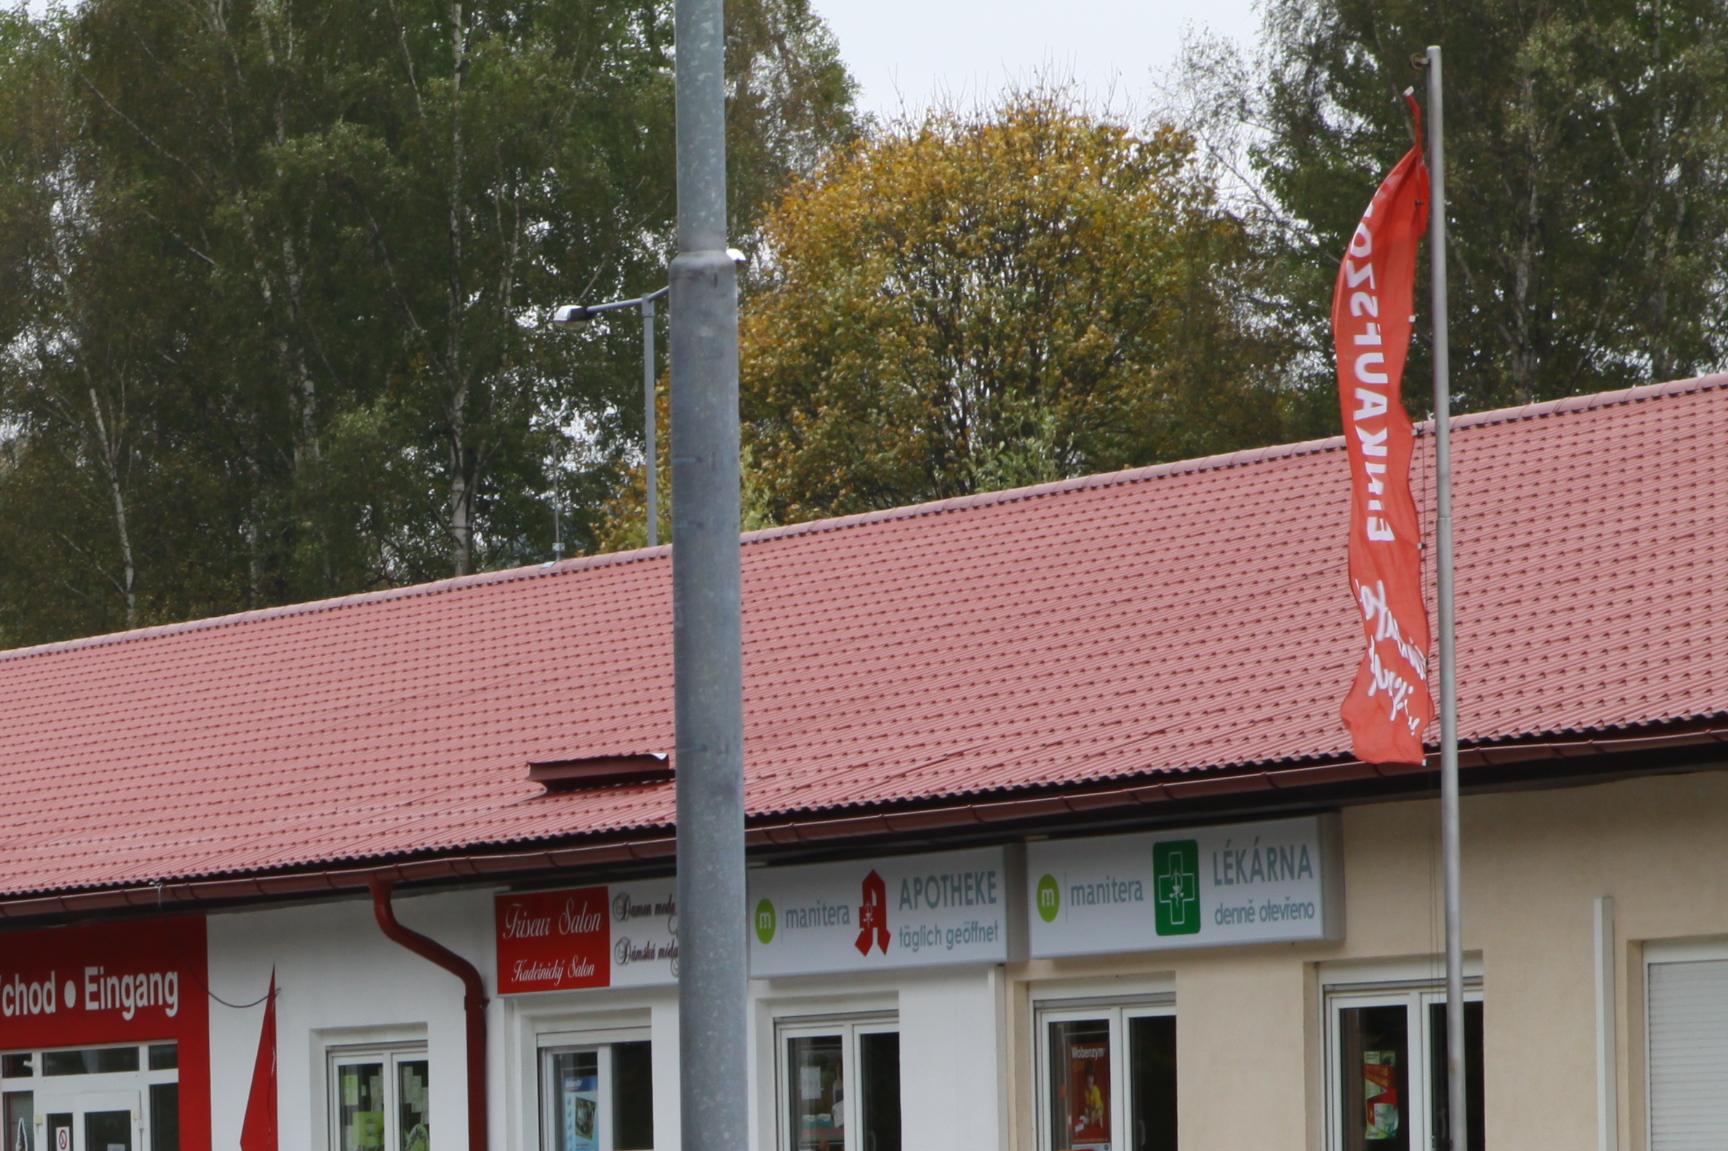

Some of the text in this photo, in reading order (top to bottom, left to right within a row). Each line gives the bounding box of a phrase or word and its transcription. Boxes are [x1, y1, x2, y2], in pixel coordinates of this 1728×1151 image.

[1213, 835, 1314, 886] LÉKÁRNA
[899, 870, 998, 911] APOTHEKE
[1071, 875, 1144, 907] manitera
[502, 899, 602, 940] Friseur Salon
[785, 900, 850, 929] manitera
[1214, 896, 1315, 926] denně otevřeno
[899, 920, 999, 952] täglich geöffnet
[567, 955, 596, 978] Salon
[84, 966, 178, 1021] Eingang
